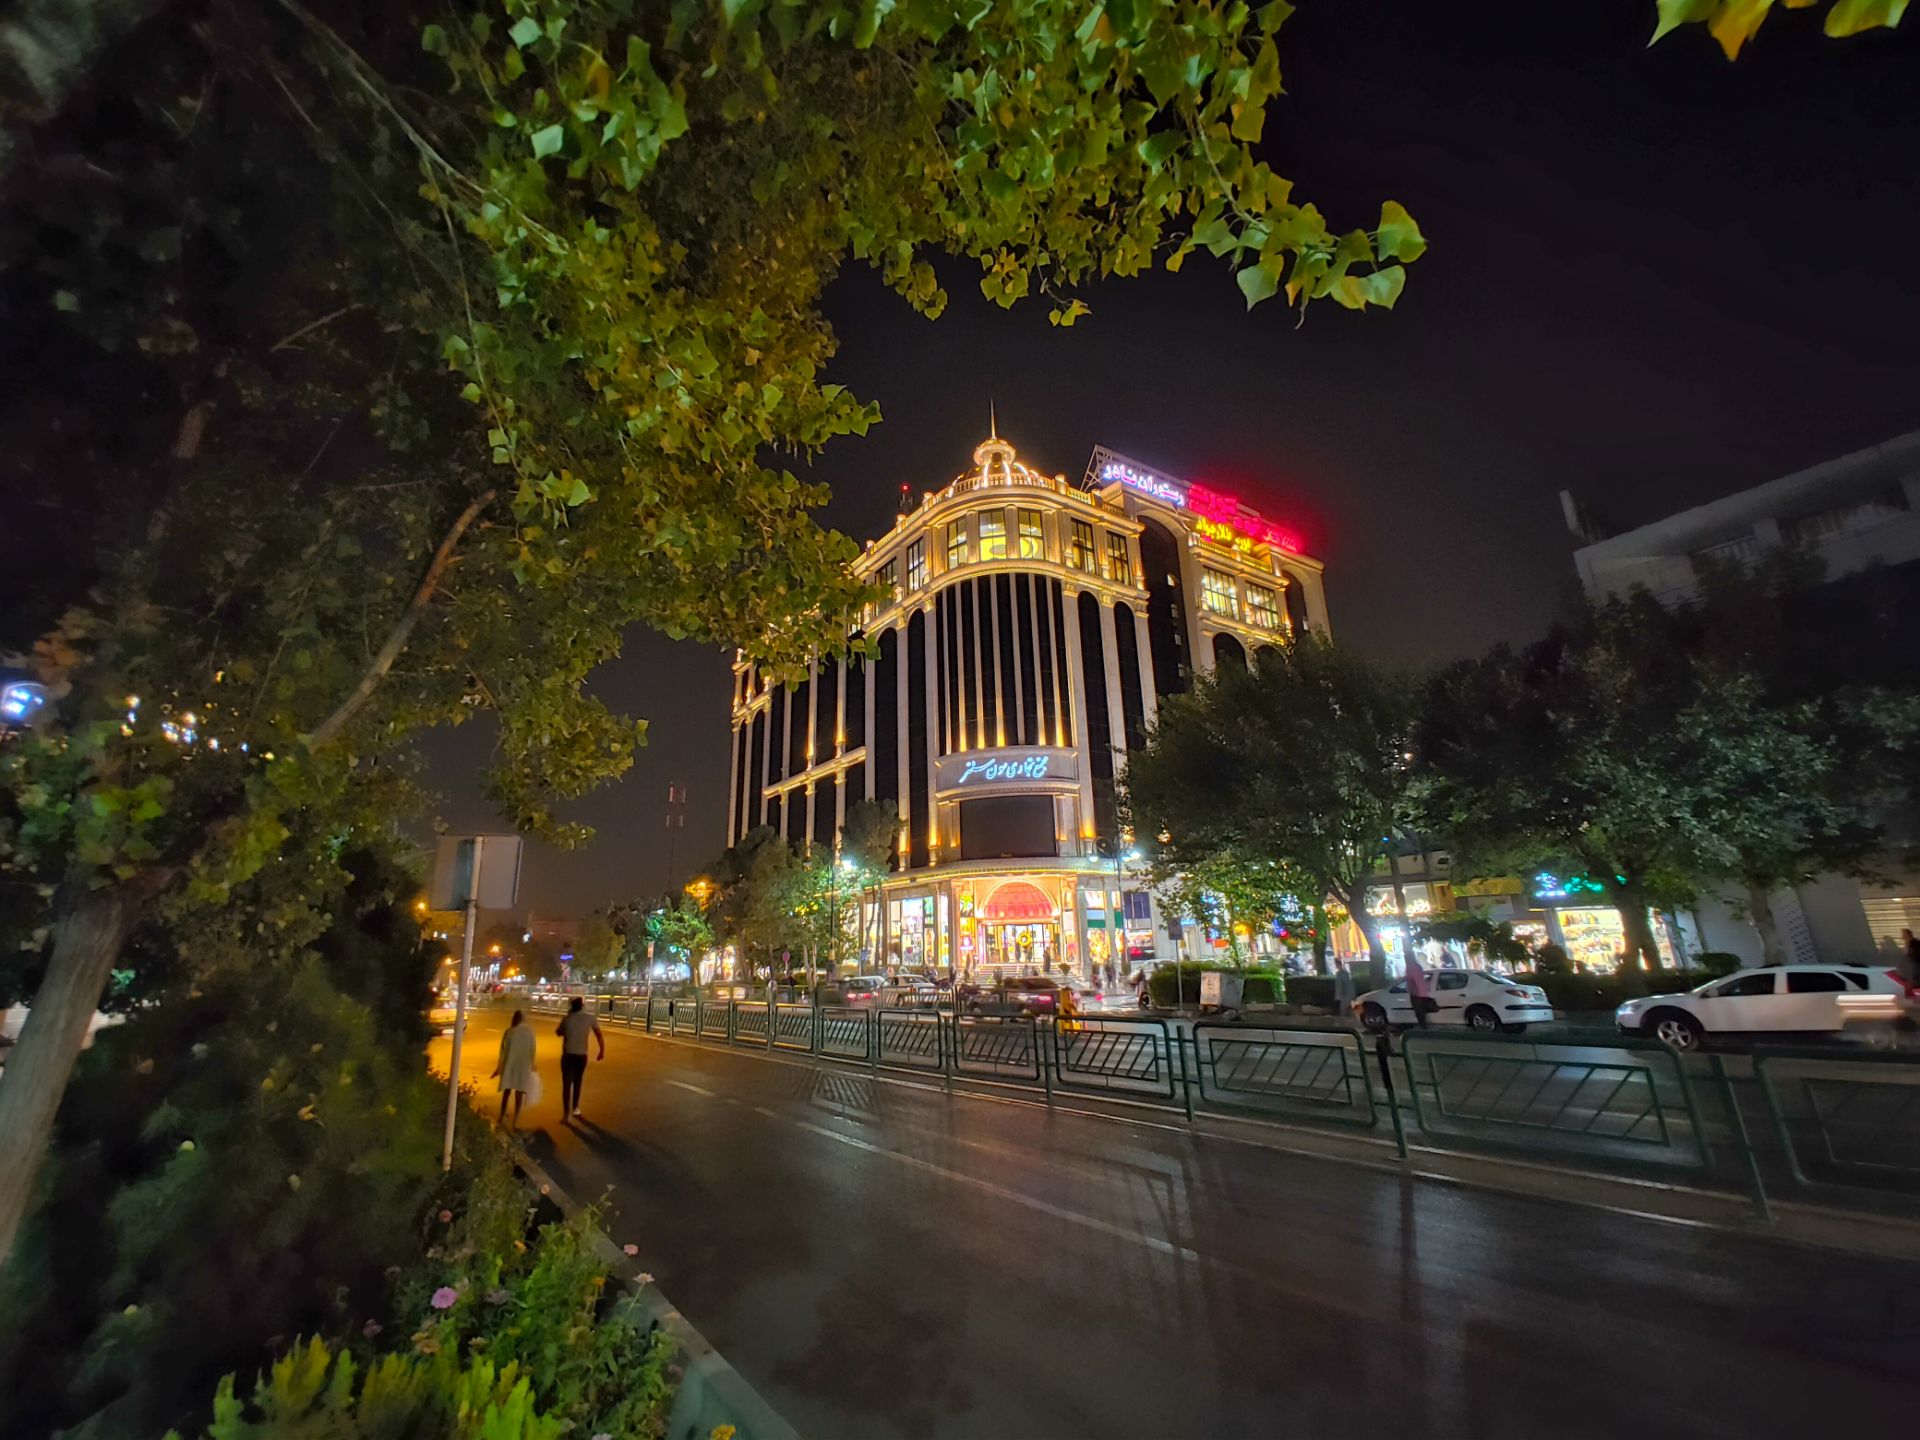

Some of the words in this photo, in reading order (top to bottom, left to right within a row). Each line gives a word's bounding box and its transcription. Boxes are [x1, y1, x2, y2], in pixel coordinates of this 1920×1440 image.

[1137, 475, 1185, 506] رستوران
[958, 758, 996, 784] سنتر
[1006, 756, 1035, 779] تجاری
